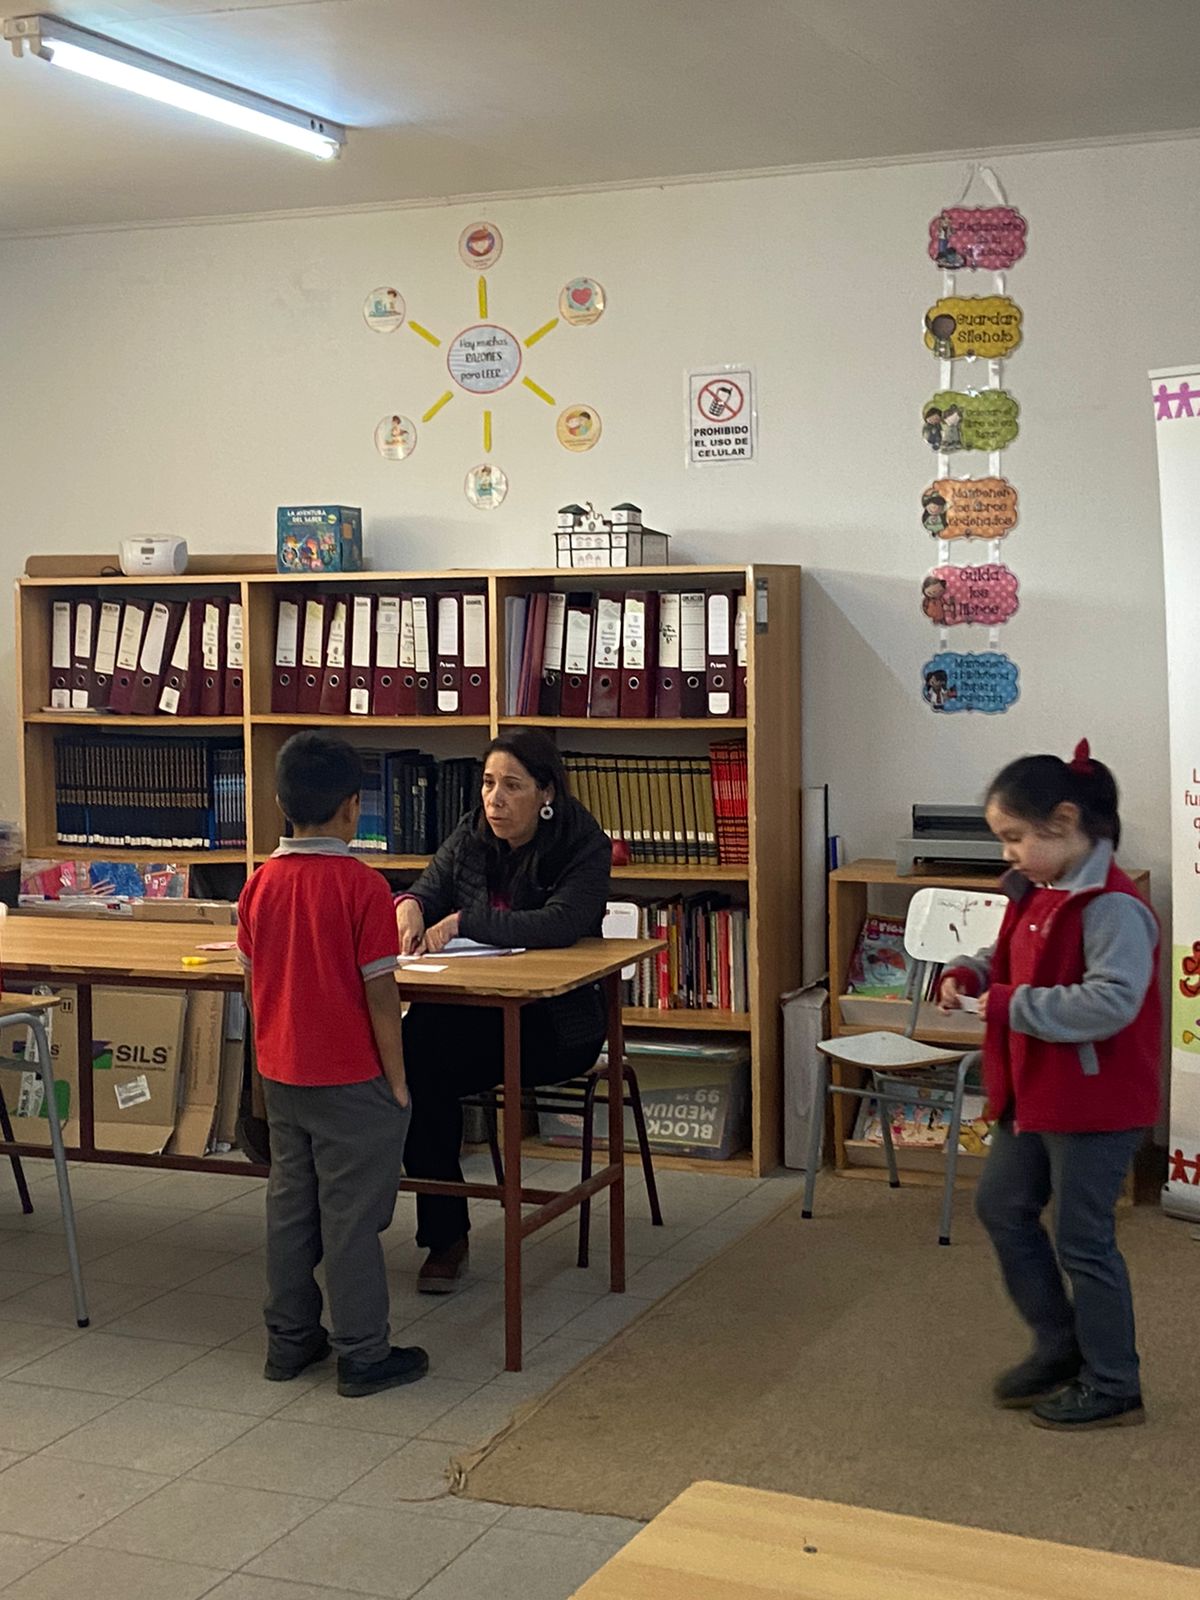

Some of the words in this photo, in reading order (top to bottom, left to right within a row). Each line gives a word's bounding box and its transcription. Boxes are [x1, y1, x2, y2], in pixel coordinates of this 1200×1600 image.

[957, 311, 1018, 326] Guardar
[693, 425, 749, 437] PROHIBIDO
[710, 438, 732, 447] USO
[734, 437, 748, 445] DE
[698, 447, 745, 458] CELULAR
[116, 1044, 167, 1064] SILS
[647, 1119, 714, 1140] BLOCK
